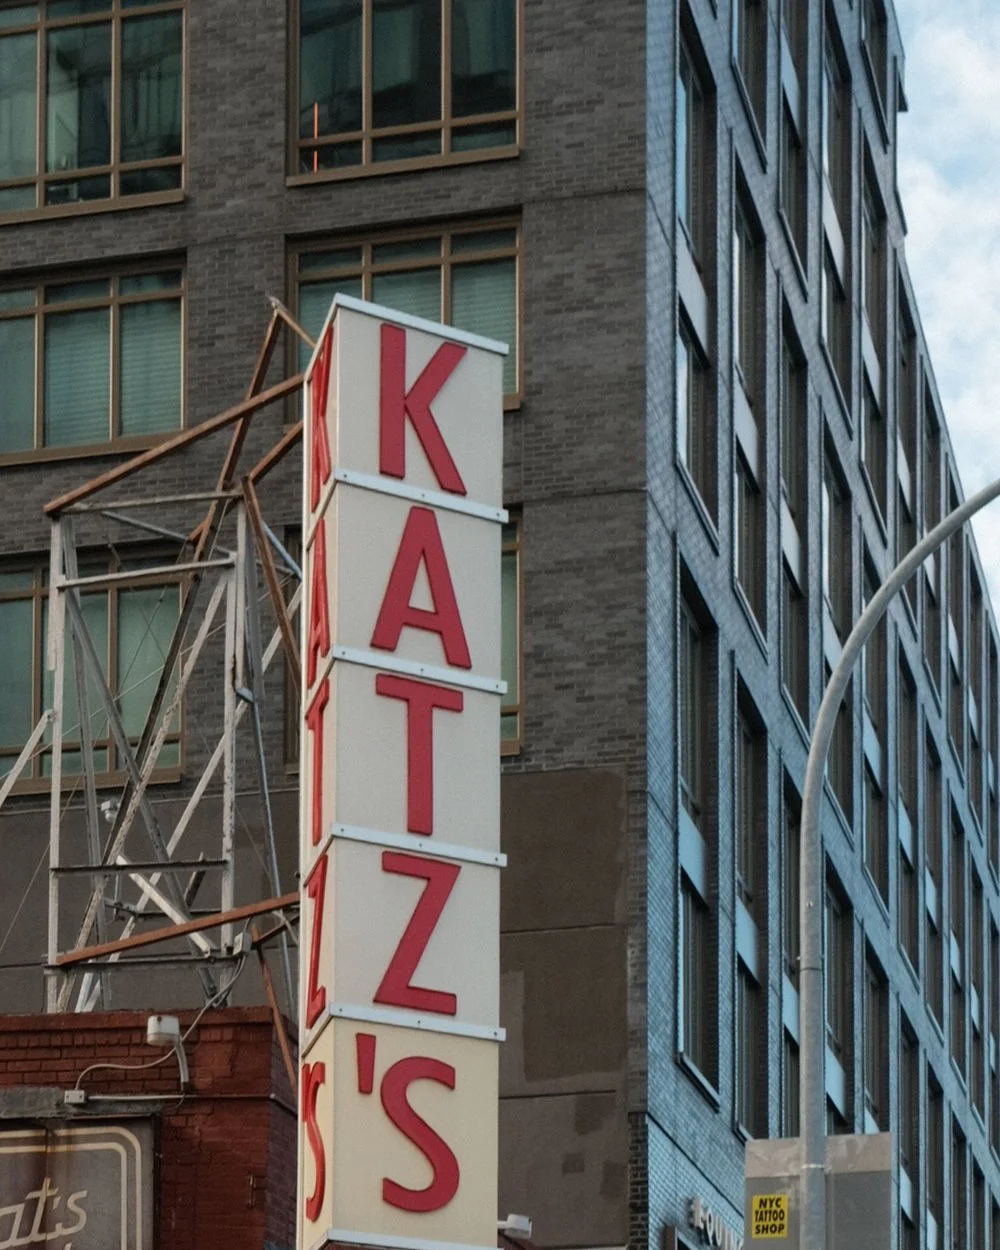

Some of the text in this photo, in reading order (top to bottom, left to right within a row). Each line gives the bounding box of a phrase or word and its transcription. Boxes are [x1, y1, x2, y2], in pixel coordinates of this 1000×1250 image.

[354, 322, 473, 1213] KATZ'S
[758, 1197, 782, 1208] NYC
[755, 1209, 785, 1222] TATTOO
[755, 1223, 785, 1234] SHOP
